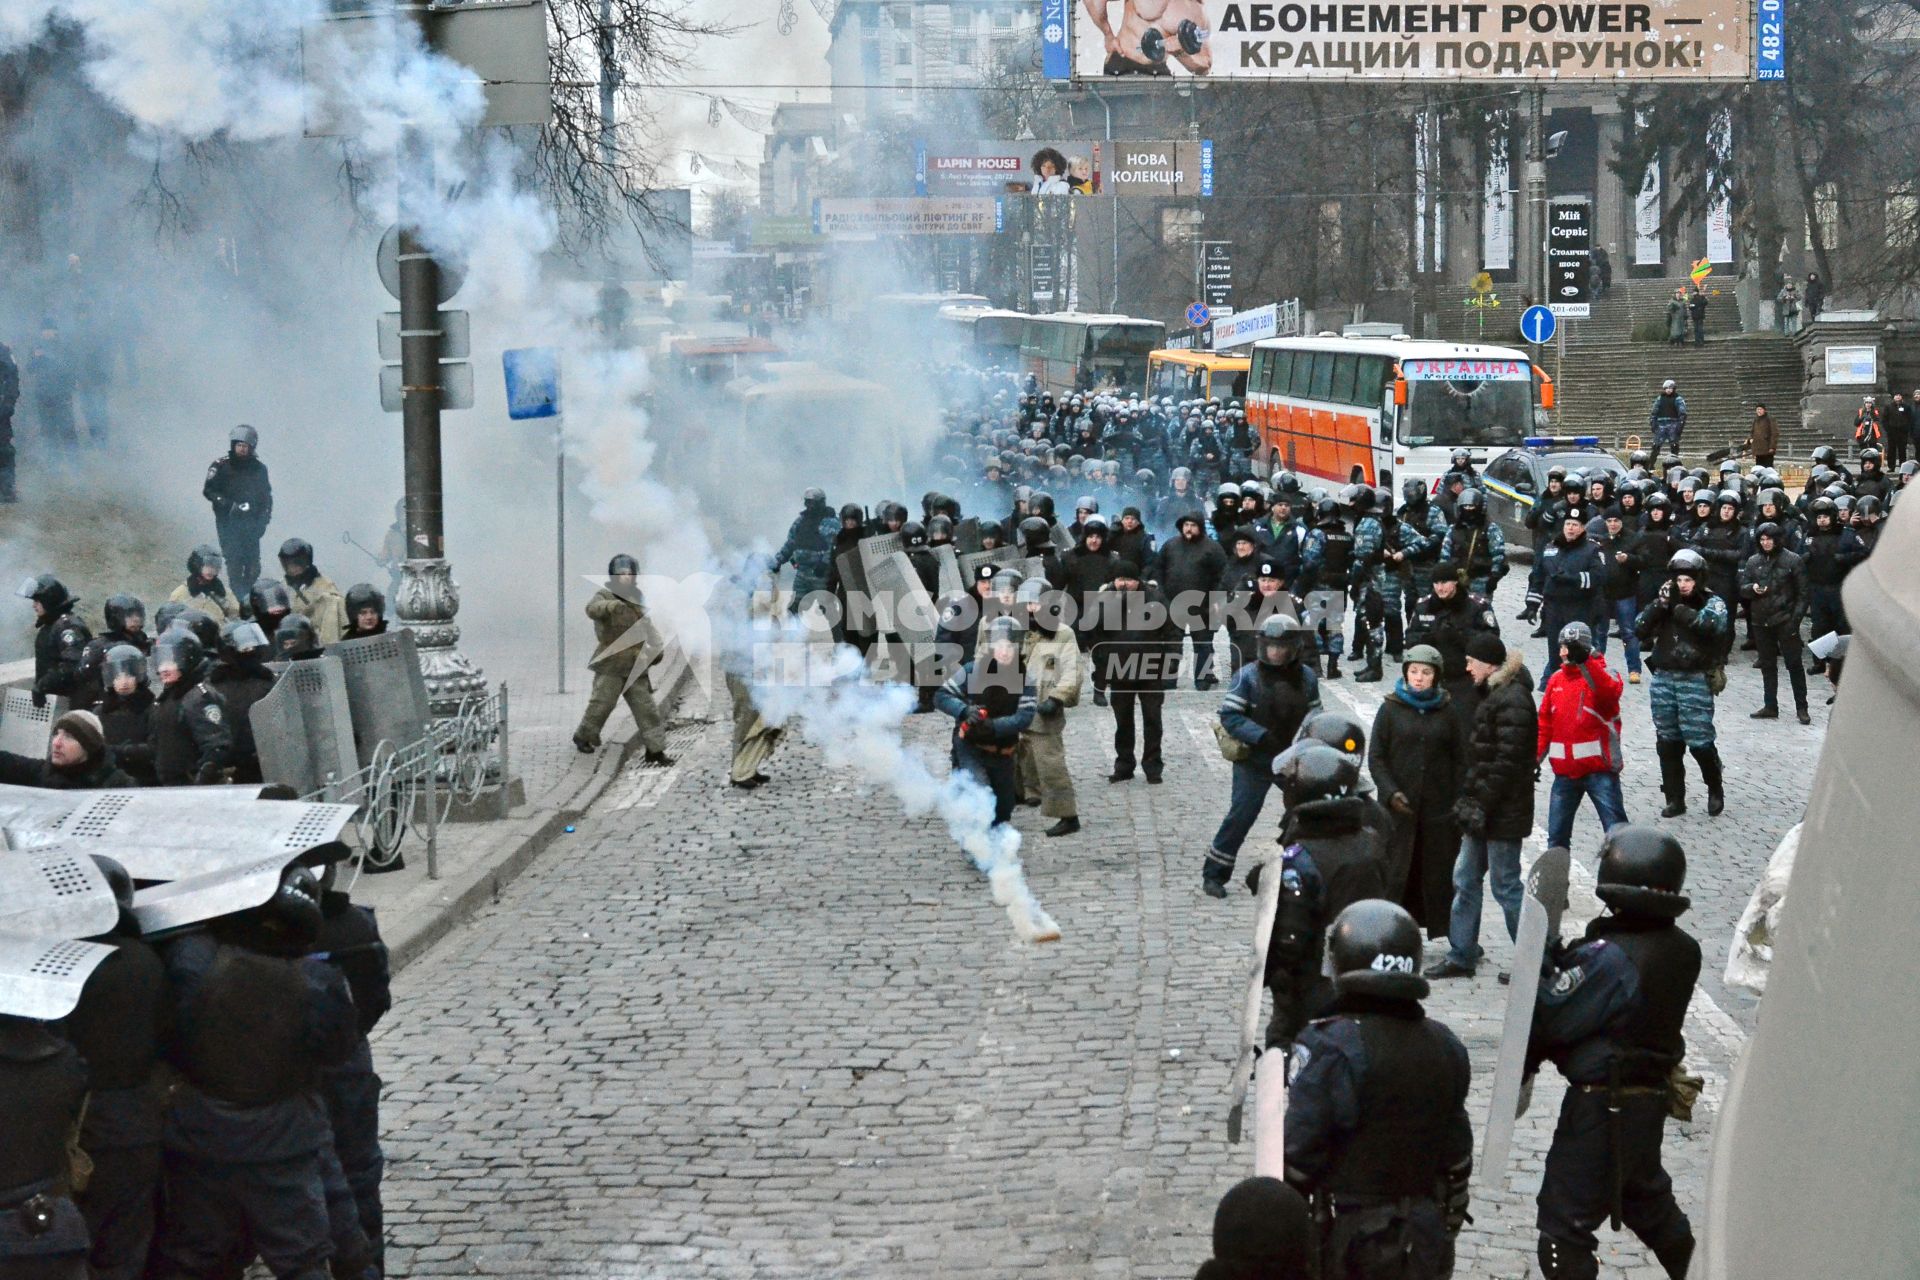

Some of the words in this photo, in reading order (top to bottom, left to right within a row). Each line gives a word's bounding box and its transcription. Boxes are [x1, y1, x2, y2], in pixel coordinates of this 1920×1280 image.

[1219, 3, 1487, 33] АБОНЕМЕНТ
[1501, 3, 1651, 33] POWER
[1240, 33, 1419, 73] КРАЩИЙ
[1435, 40, 1702, 74] ПОДАРУНОК!
[937, 158, 972, 169] LAPIN
[977, 158, 1017, 169] HOUSE
[1127, 153, 1168, 166] НОВА
[1111, 170, 1184, 185] КОЛЕКЦІЯ
[923, 213, 969, 223] ЛІФТИНГ
[1558, 211, 1581, 221] Мій
[1551, 226, 1588, 239] Сервіс
[1564, 272, 1575, 280] 90
[1552, 305, 1588, 313] 201-6000
[1414, 360, 1520, 374] УКРАИНА
